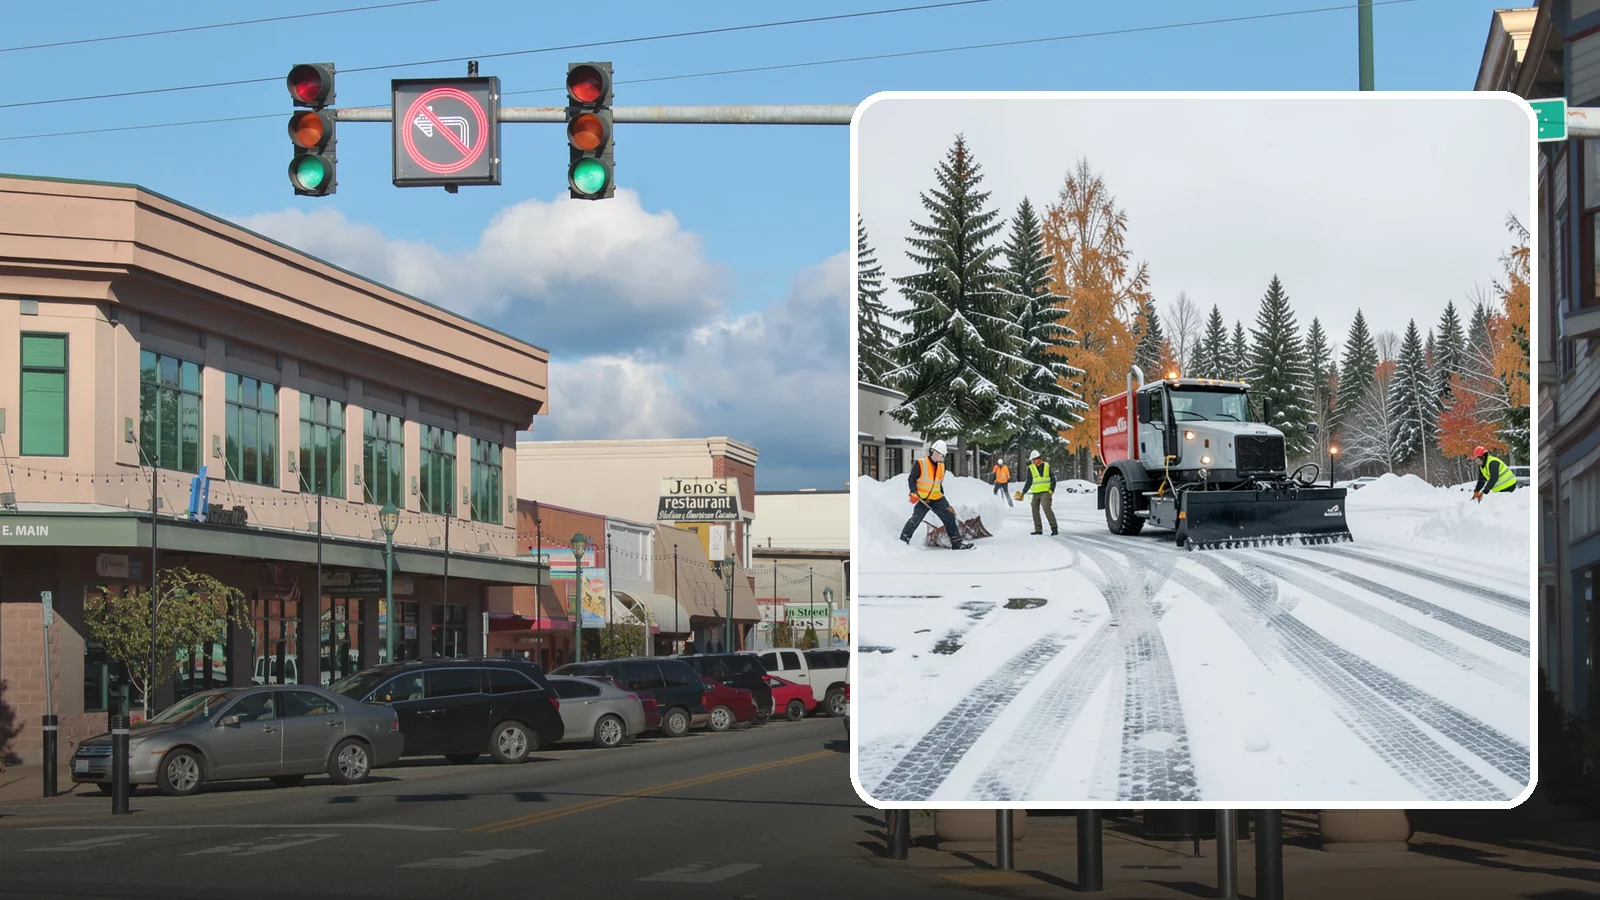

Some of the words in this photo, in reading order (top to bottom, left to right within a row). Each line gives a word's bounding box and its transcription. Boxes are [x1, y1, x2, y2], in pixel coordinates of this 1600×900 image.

[669, 480, 728, 494] Jeno's
[665, 497, 731, 509] restaurant
[658, 510, 681, 519] Italian
[686, 510, 714, 519] American
[715, 509, 737, 519] Cuisine
[2, 525, 13, 536] E.
[16, 525, 49, 536] MAIN
[797, 608, 828, 616] Street
